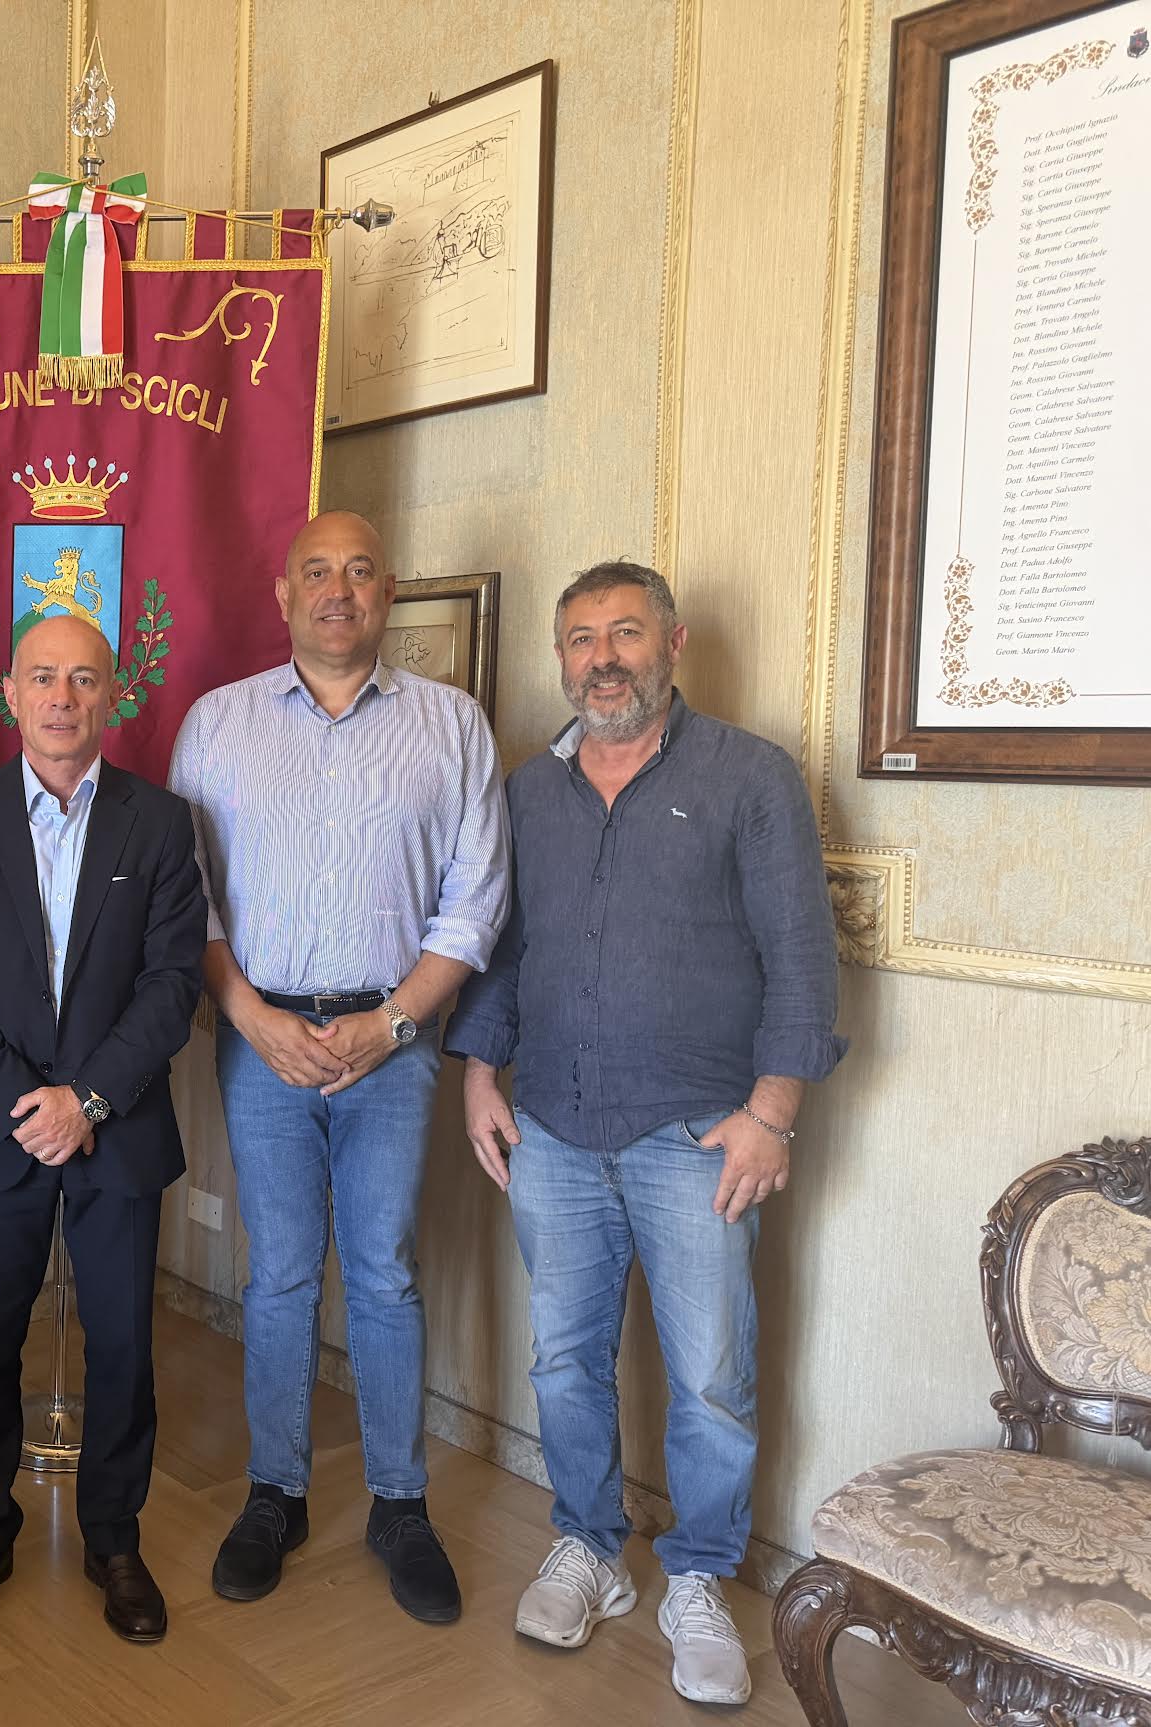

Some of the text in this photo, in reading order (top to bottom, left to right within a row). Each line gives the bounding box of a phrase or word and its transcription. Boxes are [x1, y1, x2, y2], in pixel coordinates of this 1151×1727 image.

[1045, 122, 1086, 138] Occhipinti
[1088, 114, 1118, 128] Ignazio
[1045, 143, 1064, 153] Rosa
[1066, 132, 1107, 147] Guglielmo
[1066, 148, 1103, 162] Giuseppe
[1066, 162, 1103, 176] Giuseppe
[1065, 178, 1101, 191] Giuseppe
[1075, 190, 1112, 204] Giuseppe
[1073, 205, 1111, 218] Giuseppe
[1065, 222, 1099, 235] Carmelo
[1064, 237, 1098, 249] Carmelo
[1076, 249, 1107, 261] Michele
[1059, 266, 1096, 278] Giuseppe
[1036, 286, 1071, 298] Blandino
[1074, 278, 1106, 290] Michele
[1067, 294, 1101, 306] Carmelo
[1072, 308, 1099, 319] Angelo
[1034, 329, 1068, 340] Blandino
[1070, 322, 1102, 334] Michele
[1060, 338, 1096, 350] Giovanni
[1032, 357, 1069, 370] Palazzolo
[1071, 351, 1112, 363] Guglielmo
[1059, 368, 1094, 379] Giovanni
[1036, 386, 1075, 397] Calabrese
[1077, 380, 1115, 391] Salvatore
[120, 371, 228, 433] SCICLI
[1035, 400, 1074, 411] Calabrese
[1076, 395, 1114, 405] Salvatore
[1035, 415, 1073, 425] Calabrese
[1075, 409, 1112, 420] Salvatore
[1034, 429, 1072, 440] Calabrese
[1074, 425, 1112, 434] Salvatore
[1061, 440, 1095, 450] Vincenzo
[1061, 454, 1094, 465] Carmelo
[1060, 469, 1093, 479] Vincenzo
[1021, 488, 1053, 497] Carbone
[1055, 484, 1091, 493] Salvatore
[1004, 505, 1017, 513] Ing.
[1051, 500, 1068, 508] Pino
[1003, 519, 1016, 527] Ing.
[1050, 514, 1067, 522] Pino
[1002, 533, 1015, 541] Ing.
[1049, 528, 1089, 536] Francesco
[1057, 542, 1093, 551] Giuseppe
[1043, 571, 1087, 579] Bartolomeo
[1042, 585, 1086, 593] Bartolomeo
[1060, 599, 1094, 607] Giovanni
[1017, 631, 1053, 639] Giannone
